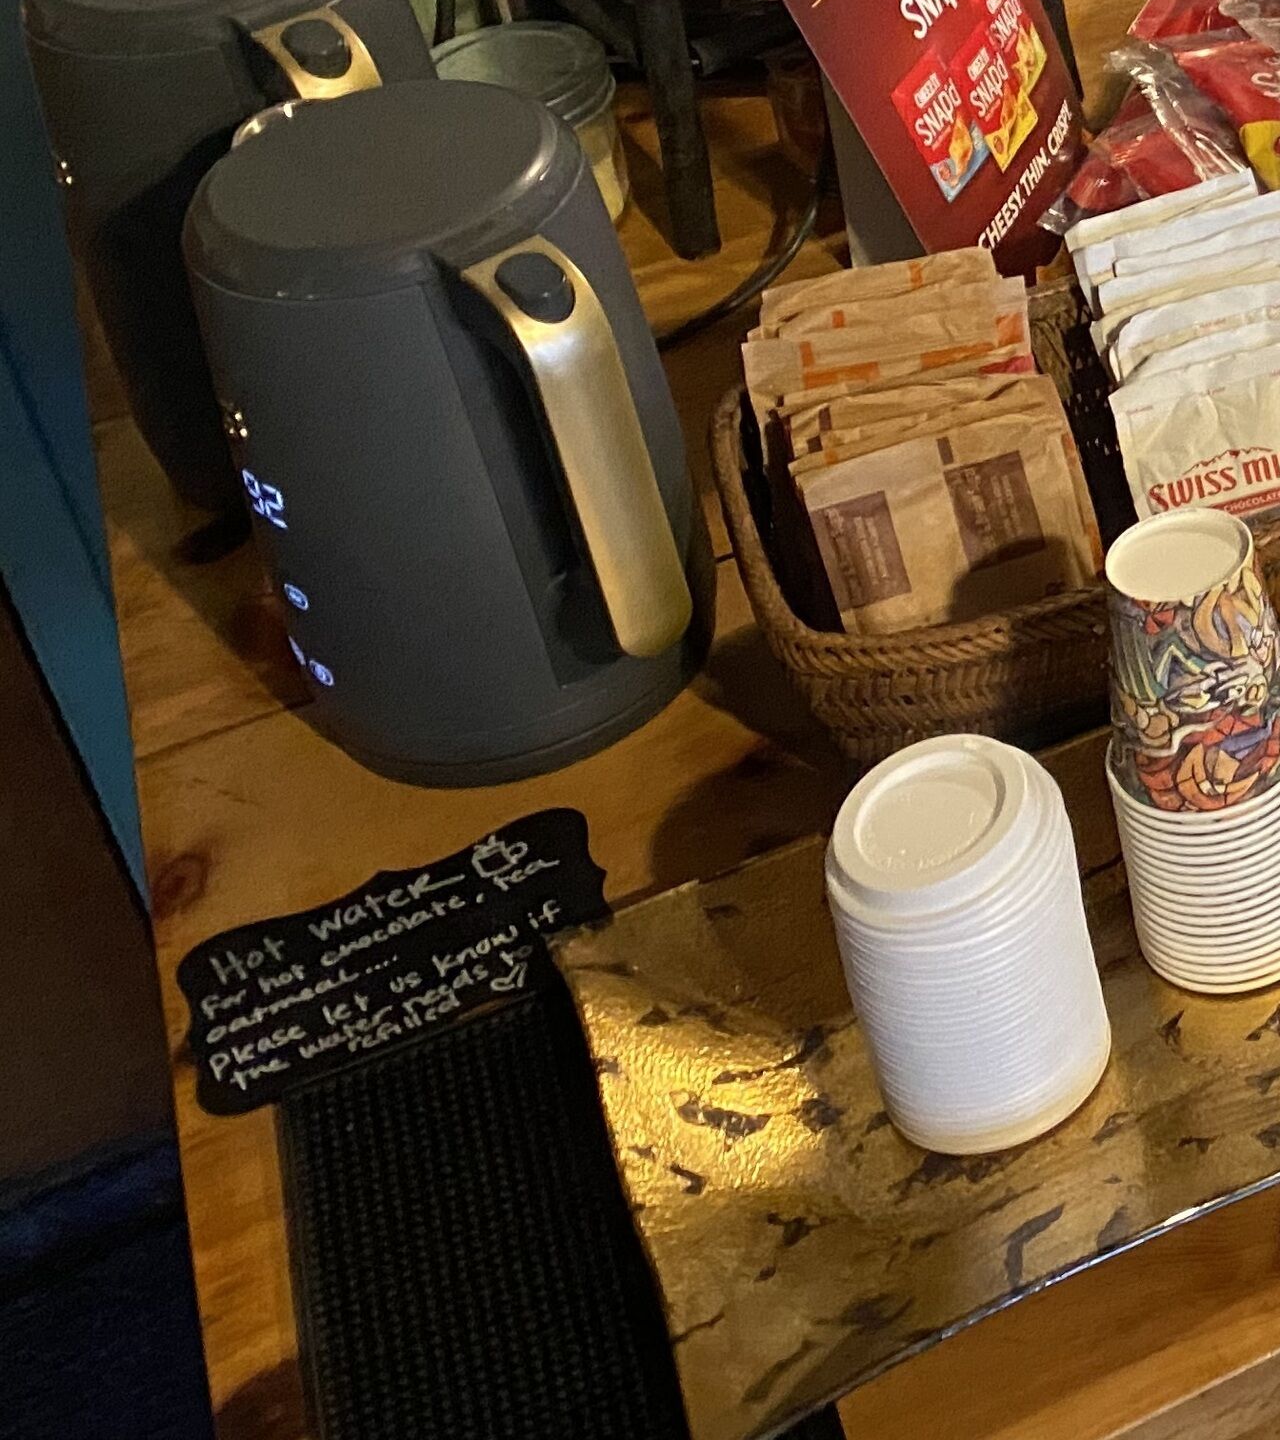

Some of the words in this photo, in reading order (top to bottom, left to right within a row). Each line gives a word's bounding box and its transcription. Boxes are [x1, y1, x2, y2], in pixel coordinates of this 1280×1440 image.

[1019, 146, 1052, 192] THIN.
[210, 936, 285, 987] Hot
[259, 963, 305, 995] hot
[493, 858, 560, 892] tea
[322, 992, 369, 1027] let
[389, 969, 423, 995] us
[432, 925, 519, 979] know
[527, 897, 562, 931] if
[230, 1056, 291, 1091] the
[299, 1004, 394, 1060] water
[502, 944, 534, 968] to
